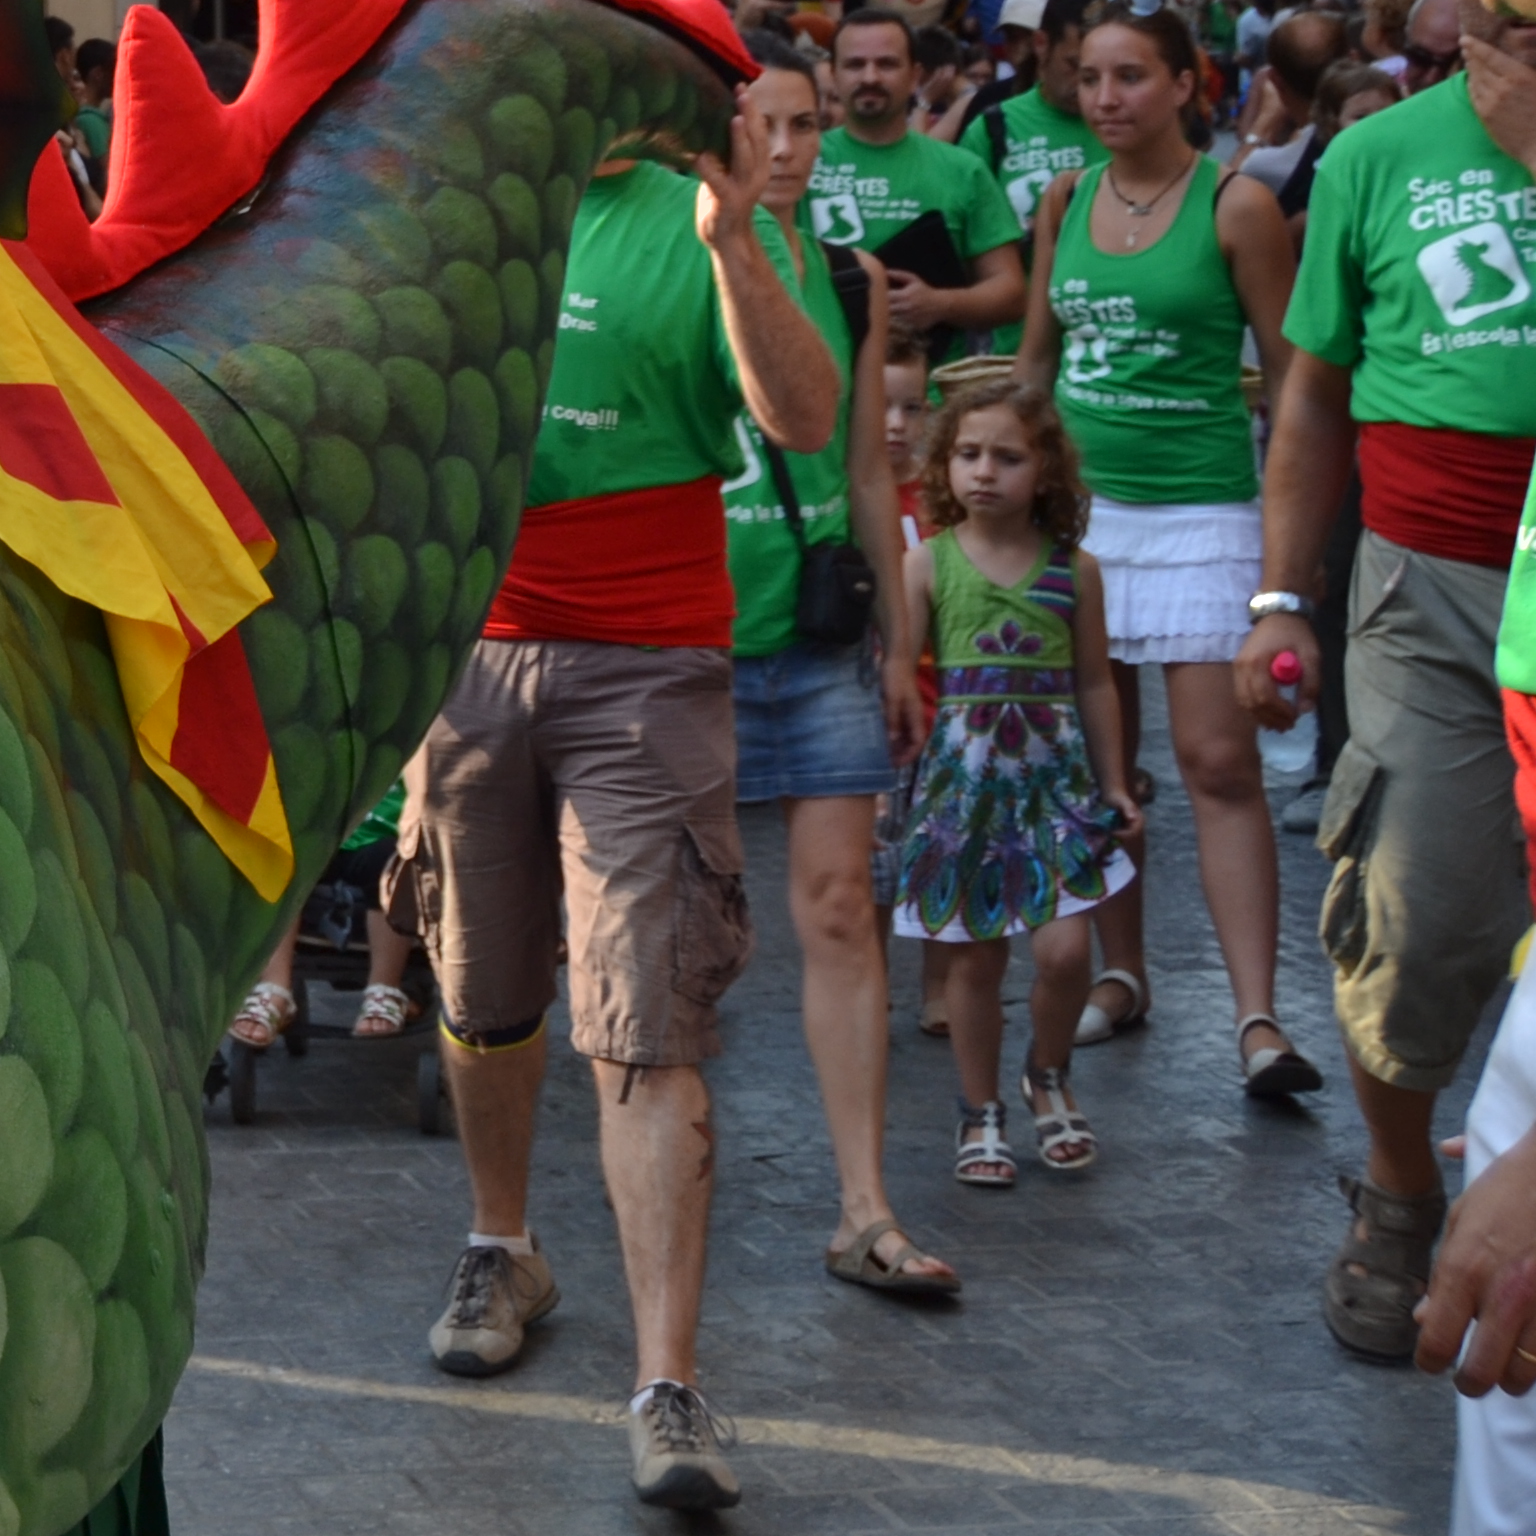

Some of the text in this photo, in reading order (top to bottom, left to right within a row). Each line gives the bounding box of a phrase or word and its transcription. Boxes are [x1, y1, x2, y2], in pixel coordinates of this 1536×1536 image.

[808, 173, 890, 197] CRESTES
[1459, 169, 1493, 186] en
[1408, 187, 1536, 231] CRESTE
[568, 293, 598, 308] Mar
[558, 313, 597, 332] Drac
[551, 406, 619, 430] cova!!!
